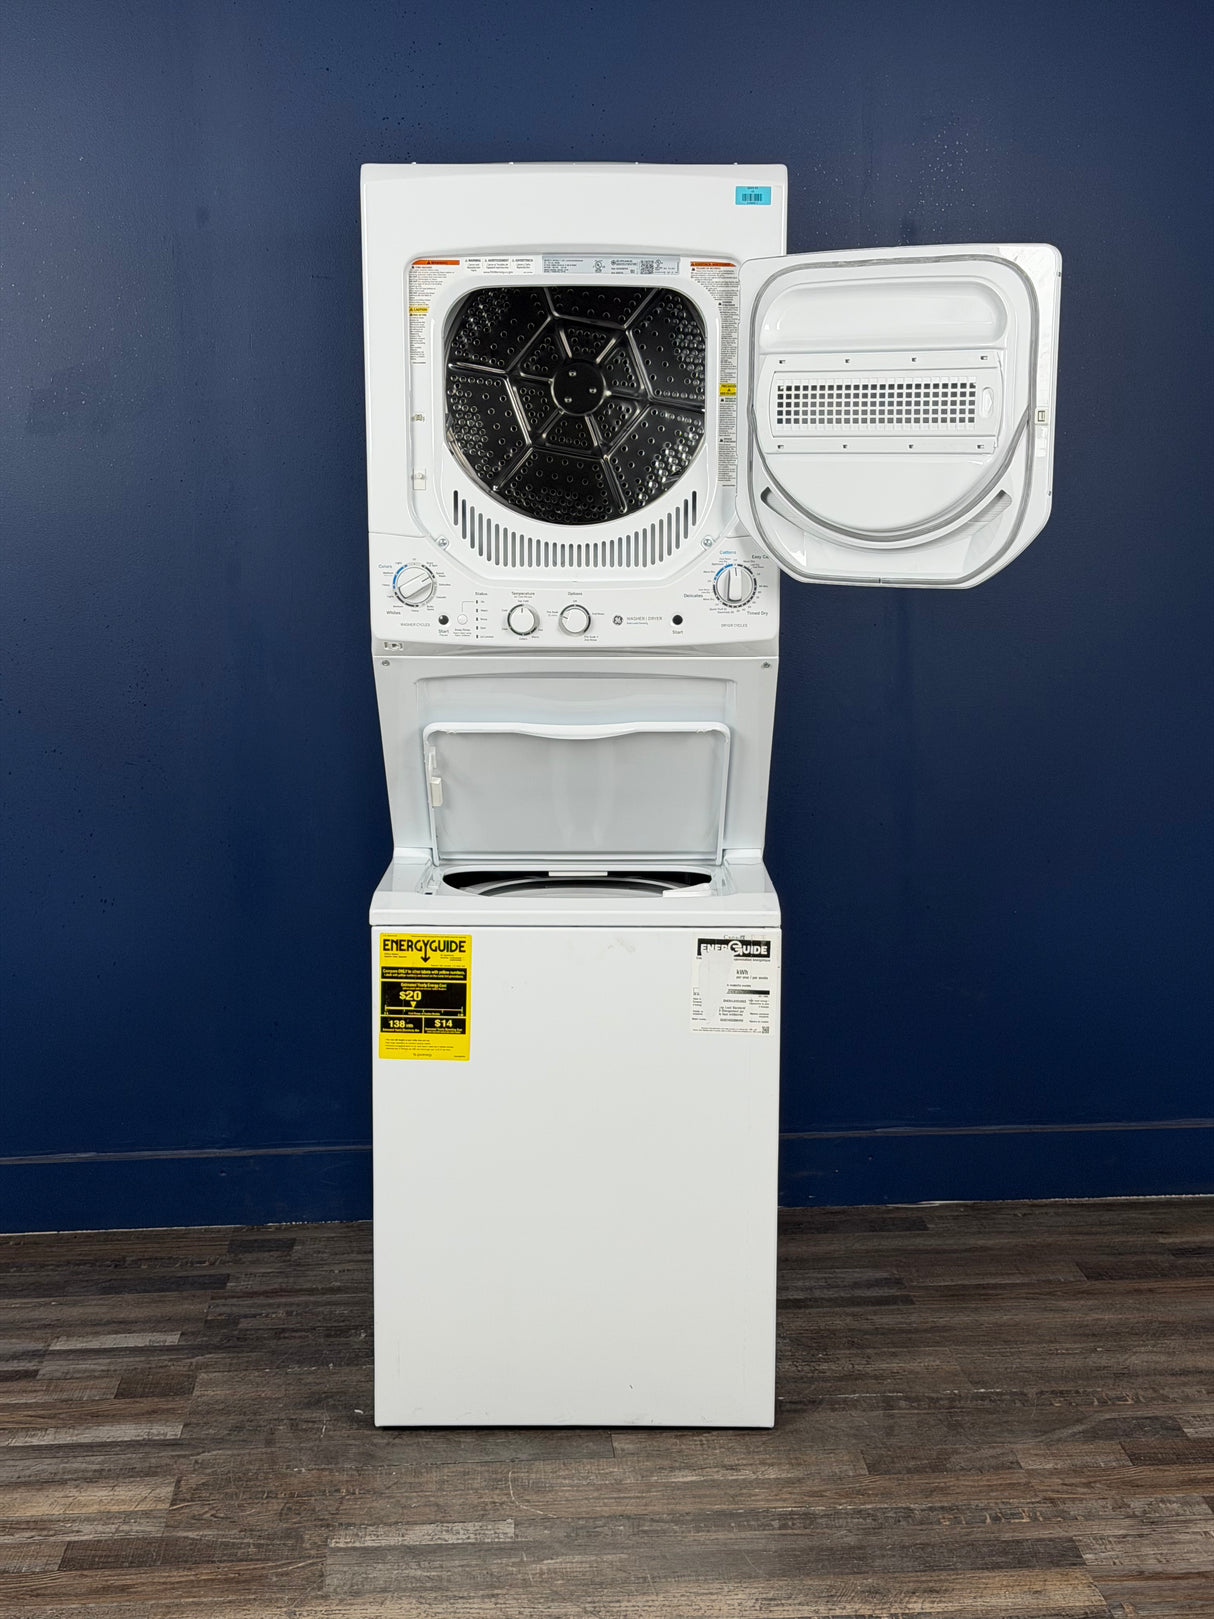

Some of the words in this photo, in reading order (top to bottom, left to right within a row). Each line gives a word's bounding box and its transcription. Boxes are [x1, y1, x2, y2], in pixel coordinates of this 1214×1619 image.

[383, 939, 467, 953] ENERGYGUIDE
[399, 991, 422, 1001] $20
[388, 1019, 405, 1028] 138
[434, 1019, 453, 1028] $14
